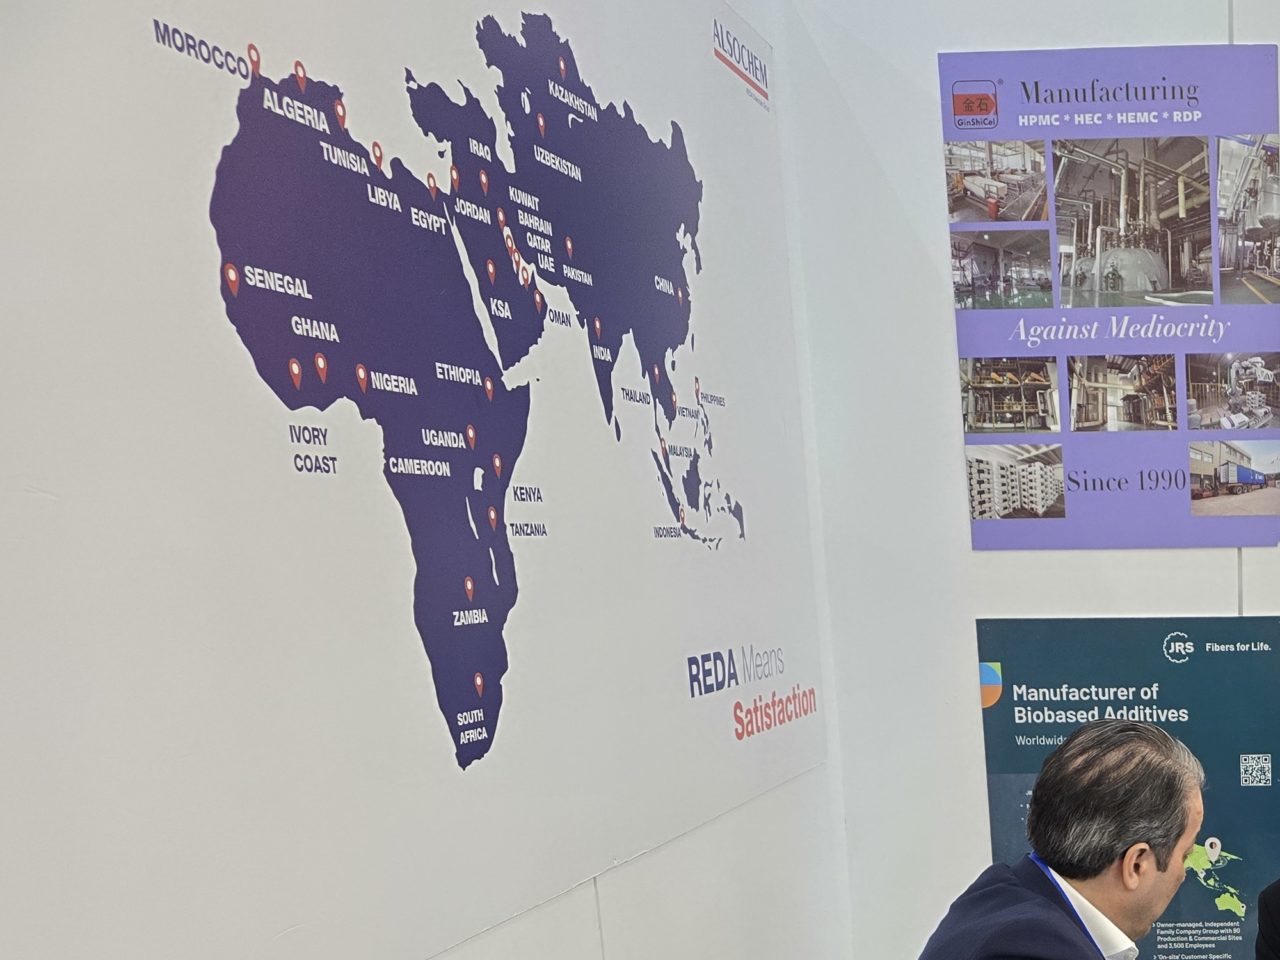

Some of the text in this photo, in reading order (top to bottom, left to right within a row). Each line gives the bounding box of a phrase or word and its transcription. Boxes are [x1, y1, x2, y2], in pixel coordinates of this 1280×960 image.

[153, 18, 250, 81] MOROCCO
[713, 18, 768, 89] ALSOCHEM
[548, 80, 598, 122] KAZAKHSTAN
[1019, 76, 1200, 108] Manufacturing
[263, 88, 330, 134] ALGERIA
[1018, 110, 1202, 127] HPMC HEC HEMC RDP
[320, 141, 370, 176] TUNISIA
[469, 138, 491, 162] IRAQ
[533, 145, 582, 182] UZBEKISTAN
[367, 184, 401, 212] LIBYA
[509, 186, 539, 210] KUWAIT
[411, 207, 446, 235] EGYPT
[454, 198, 491, 224] JORDAN
[518, 209, 552, 236] BAHRAIN
[526, 232, 551, 254] QATAR
[537, 254, 555, 273] UAE
[244, 265, 313, 300] SENEGAL
[563, 264, 592, 286] PAKISTAN
[655, 275, 674, 296] CHINA
[490, 298, 512, 320] KSA
[548, 308, 571, 327] OMAN
[291, 316, 340, 343] GHANA
[1008, 313, 1232, 348] Against Mediocrity
[593, 345, 612, 363] INDIA
[371, 371, 418, 396] NIGERIA
[435, 362, 482, 386] ETHIOPIA
[621, 387, 651, 405] THAILAND
[700, 391, 726, 407] PHILIPPINES
[677, 406, 700, 420] VIETNAM
[289, 424, 328, 446] IVORY
[421, 428, 466, 449] UGANDA
[667, 444, 693, 459] MALAYSIA
[293, 453, 337, 475] COAST
[389, 456, 451, 477] CAMEROON
[1066, 467, 1187, 493] Since 1990
[513, 486, 543, 503] KENYA
[509, 523, 547, 537] TANZANIA
[653, 526, 682, 538] INDONESIA
[453, 608, 488, 626] ZAMBIA
[1168, 641, 1272, 654] JRS Fibers for Life.
[687, 643, 785, 698] REDA Means
[1012, 683, 1159, 701] Manufacturer of
[457, 708, 484, 726] SOUTH
[732, 683, 817, 741] Satisfaction
[1014, 705, 1189, 724] Biobased Additives
[459, 726, 488, 745] AFRICA
